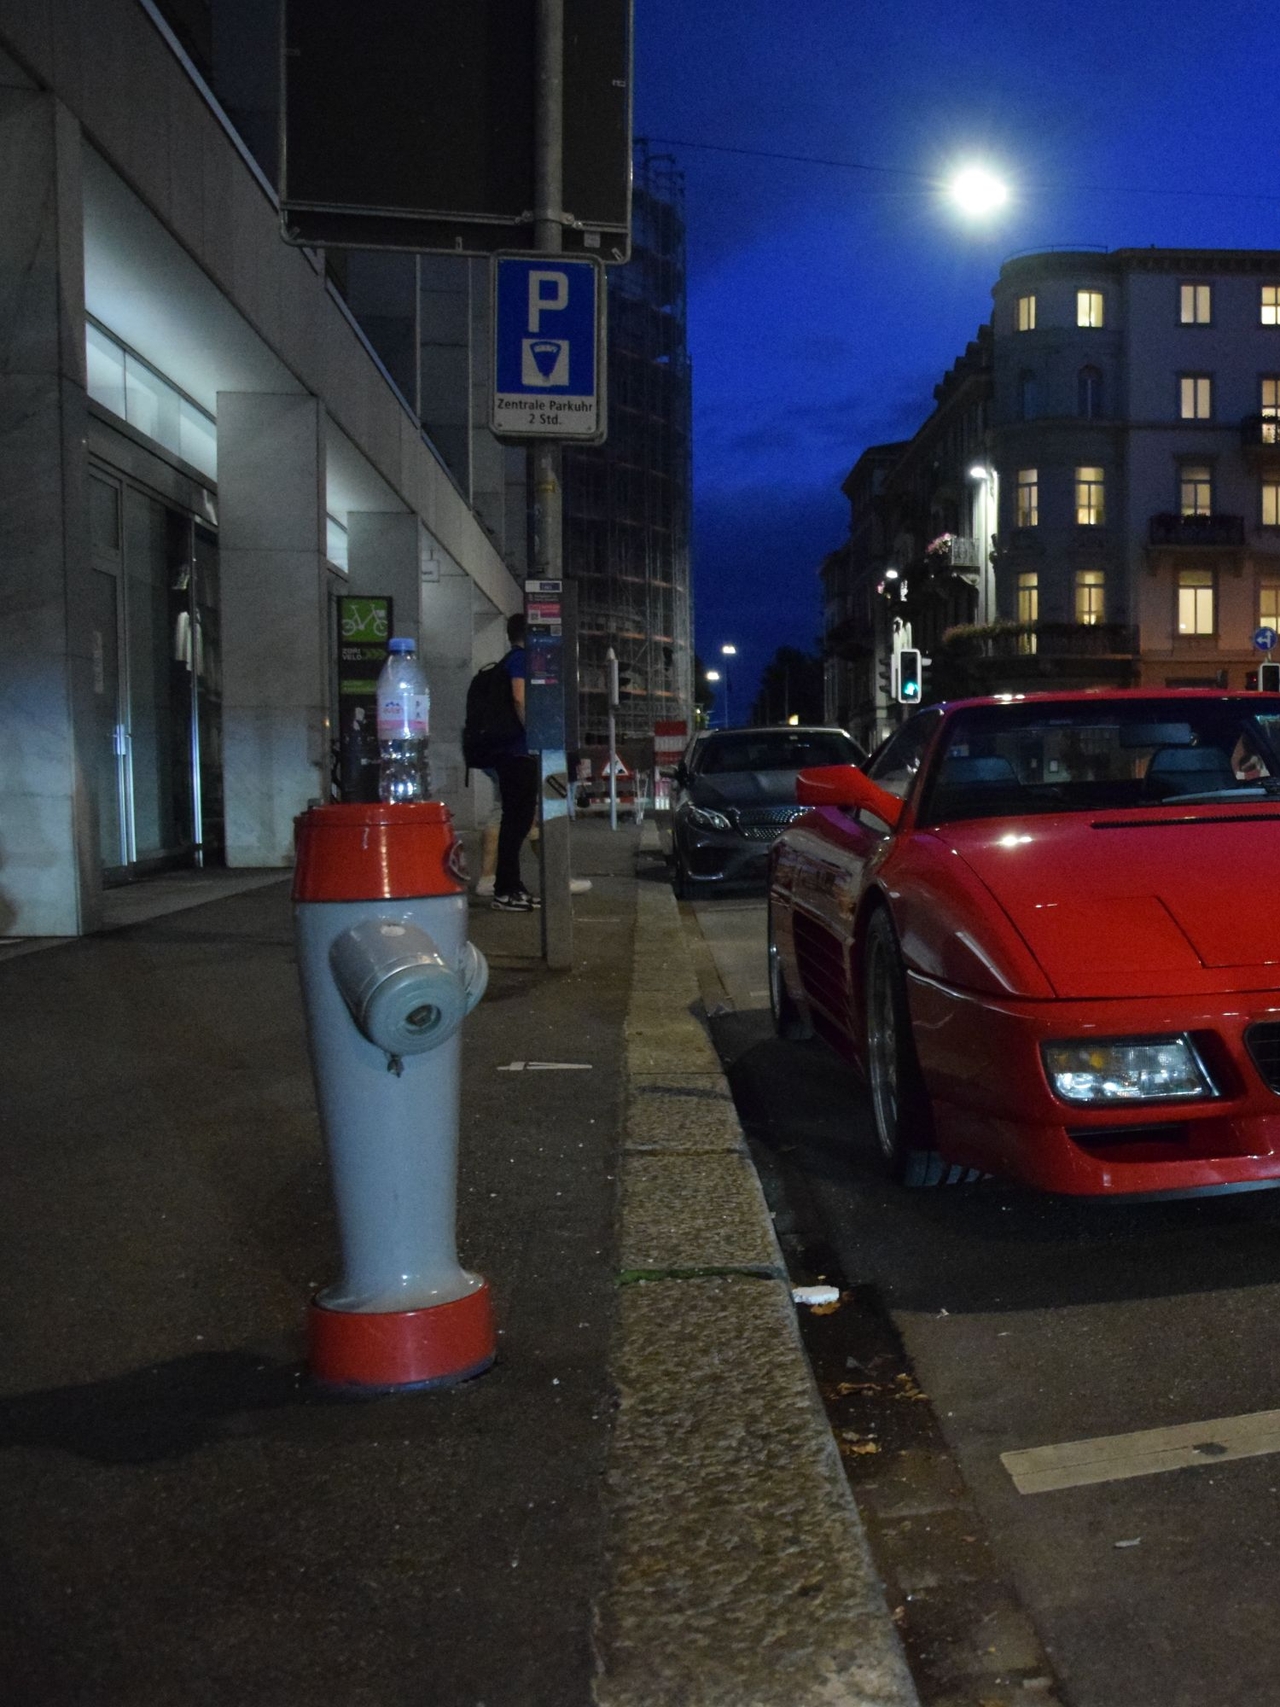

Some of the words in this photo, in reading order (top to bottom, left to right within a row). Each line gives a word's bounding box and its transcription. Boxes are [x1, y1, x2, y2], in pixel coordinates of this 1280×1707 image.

[528, 270, 569, 333] P
[497, 398, 546, 411] Zentrale
[549, 400, 593, 412] Parkuhr
[529, 413, 535, 424] 2
[539, 414, 562, 425] Std.
